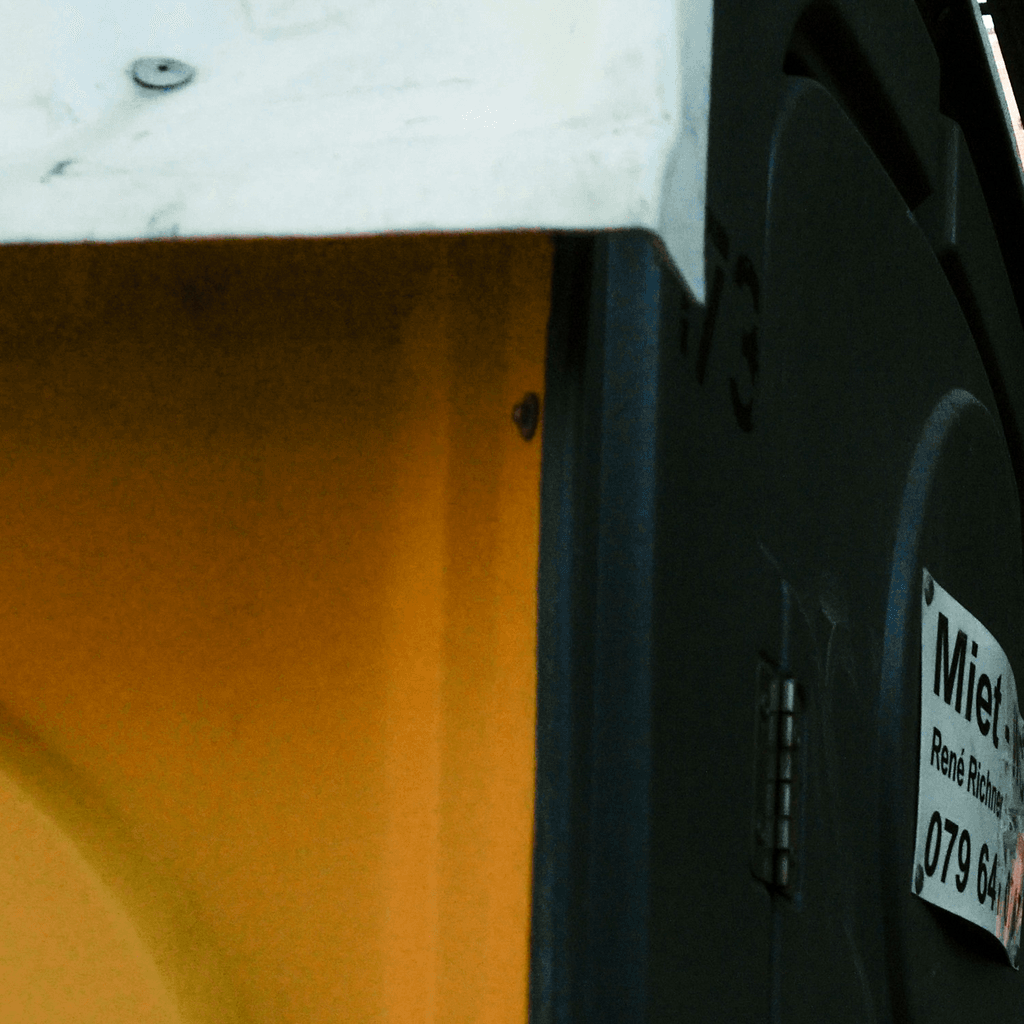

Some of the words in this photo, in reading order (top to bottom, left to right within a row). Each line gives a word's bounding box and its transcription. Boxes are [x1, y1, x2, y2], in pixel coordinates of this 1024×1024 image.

[680, 208, 761, 433] 73
[930, 726, 965, 787] René
[924, 810, 971, 893] 079
[977, 843, 1001, 914] 64
